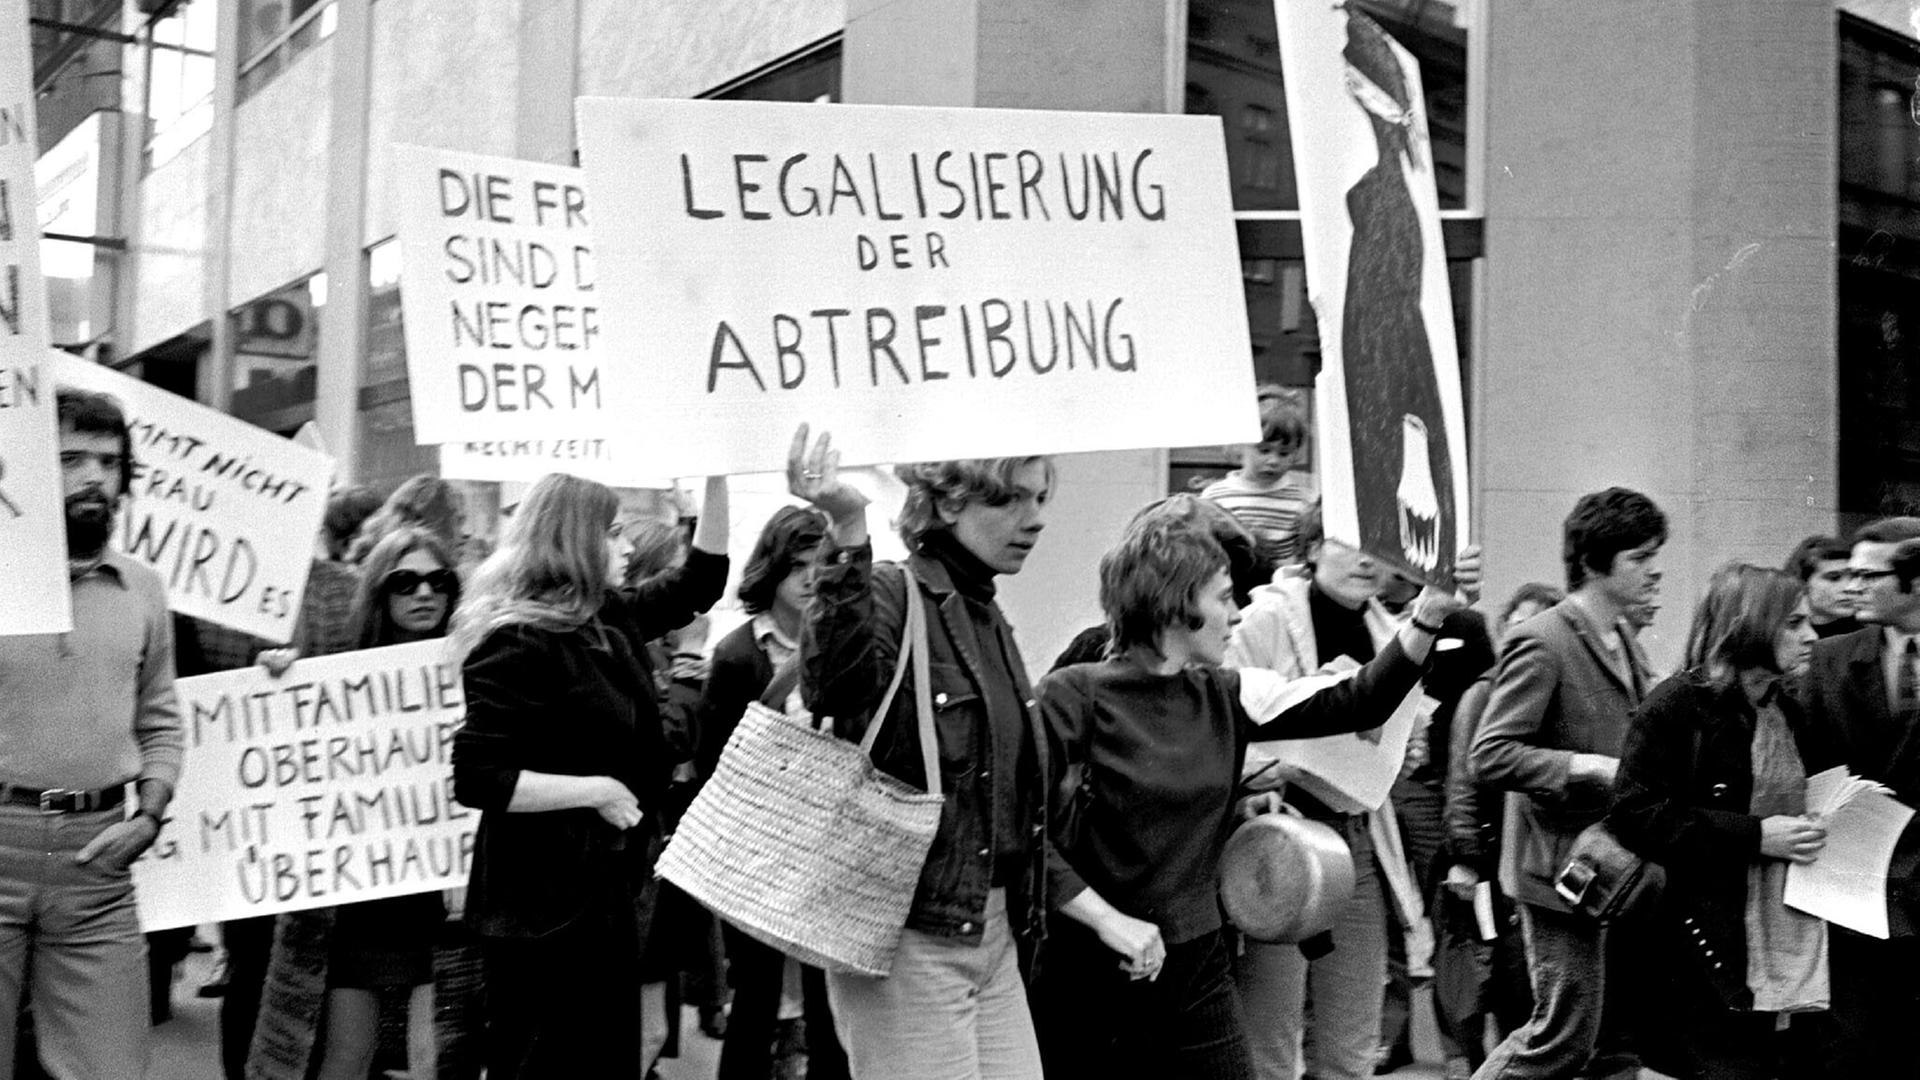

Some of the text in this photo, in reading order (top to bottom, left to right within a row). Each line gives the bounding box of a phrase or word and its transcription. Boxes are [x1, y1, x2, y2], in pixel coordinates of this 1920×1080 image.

[438, 167, 589, 229] DIE FR
[680, 148, 1166, 222] LEGALISIERUNG
[444, 234, 557, 290] SIND
[857, 231, 949, 271] DER
[706, 296, 1138, 394] ABTREIBUNG
[458, 362, 554, 413] DER
[128, 460, 217, 513] FRAU
[201, 452, 310, 505] NICHT
[123, 500, 294, 620] WIRD ES
[192, 661, 462, 748] MIT FAMILIE
[199, 801, 276, 855] MIT
